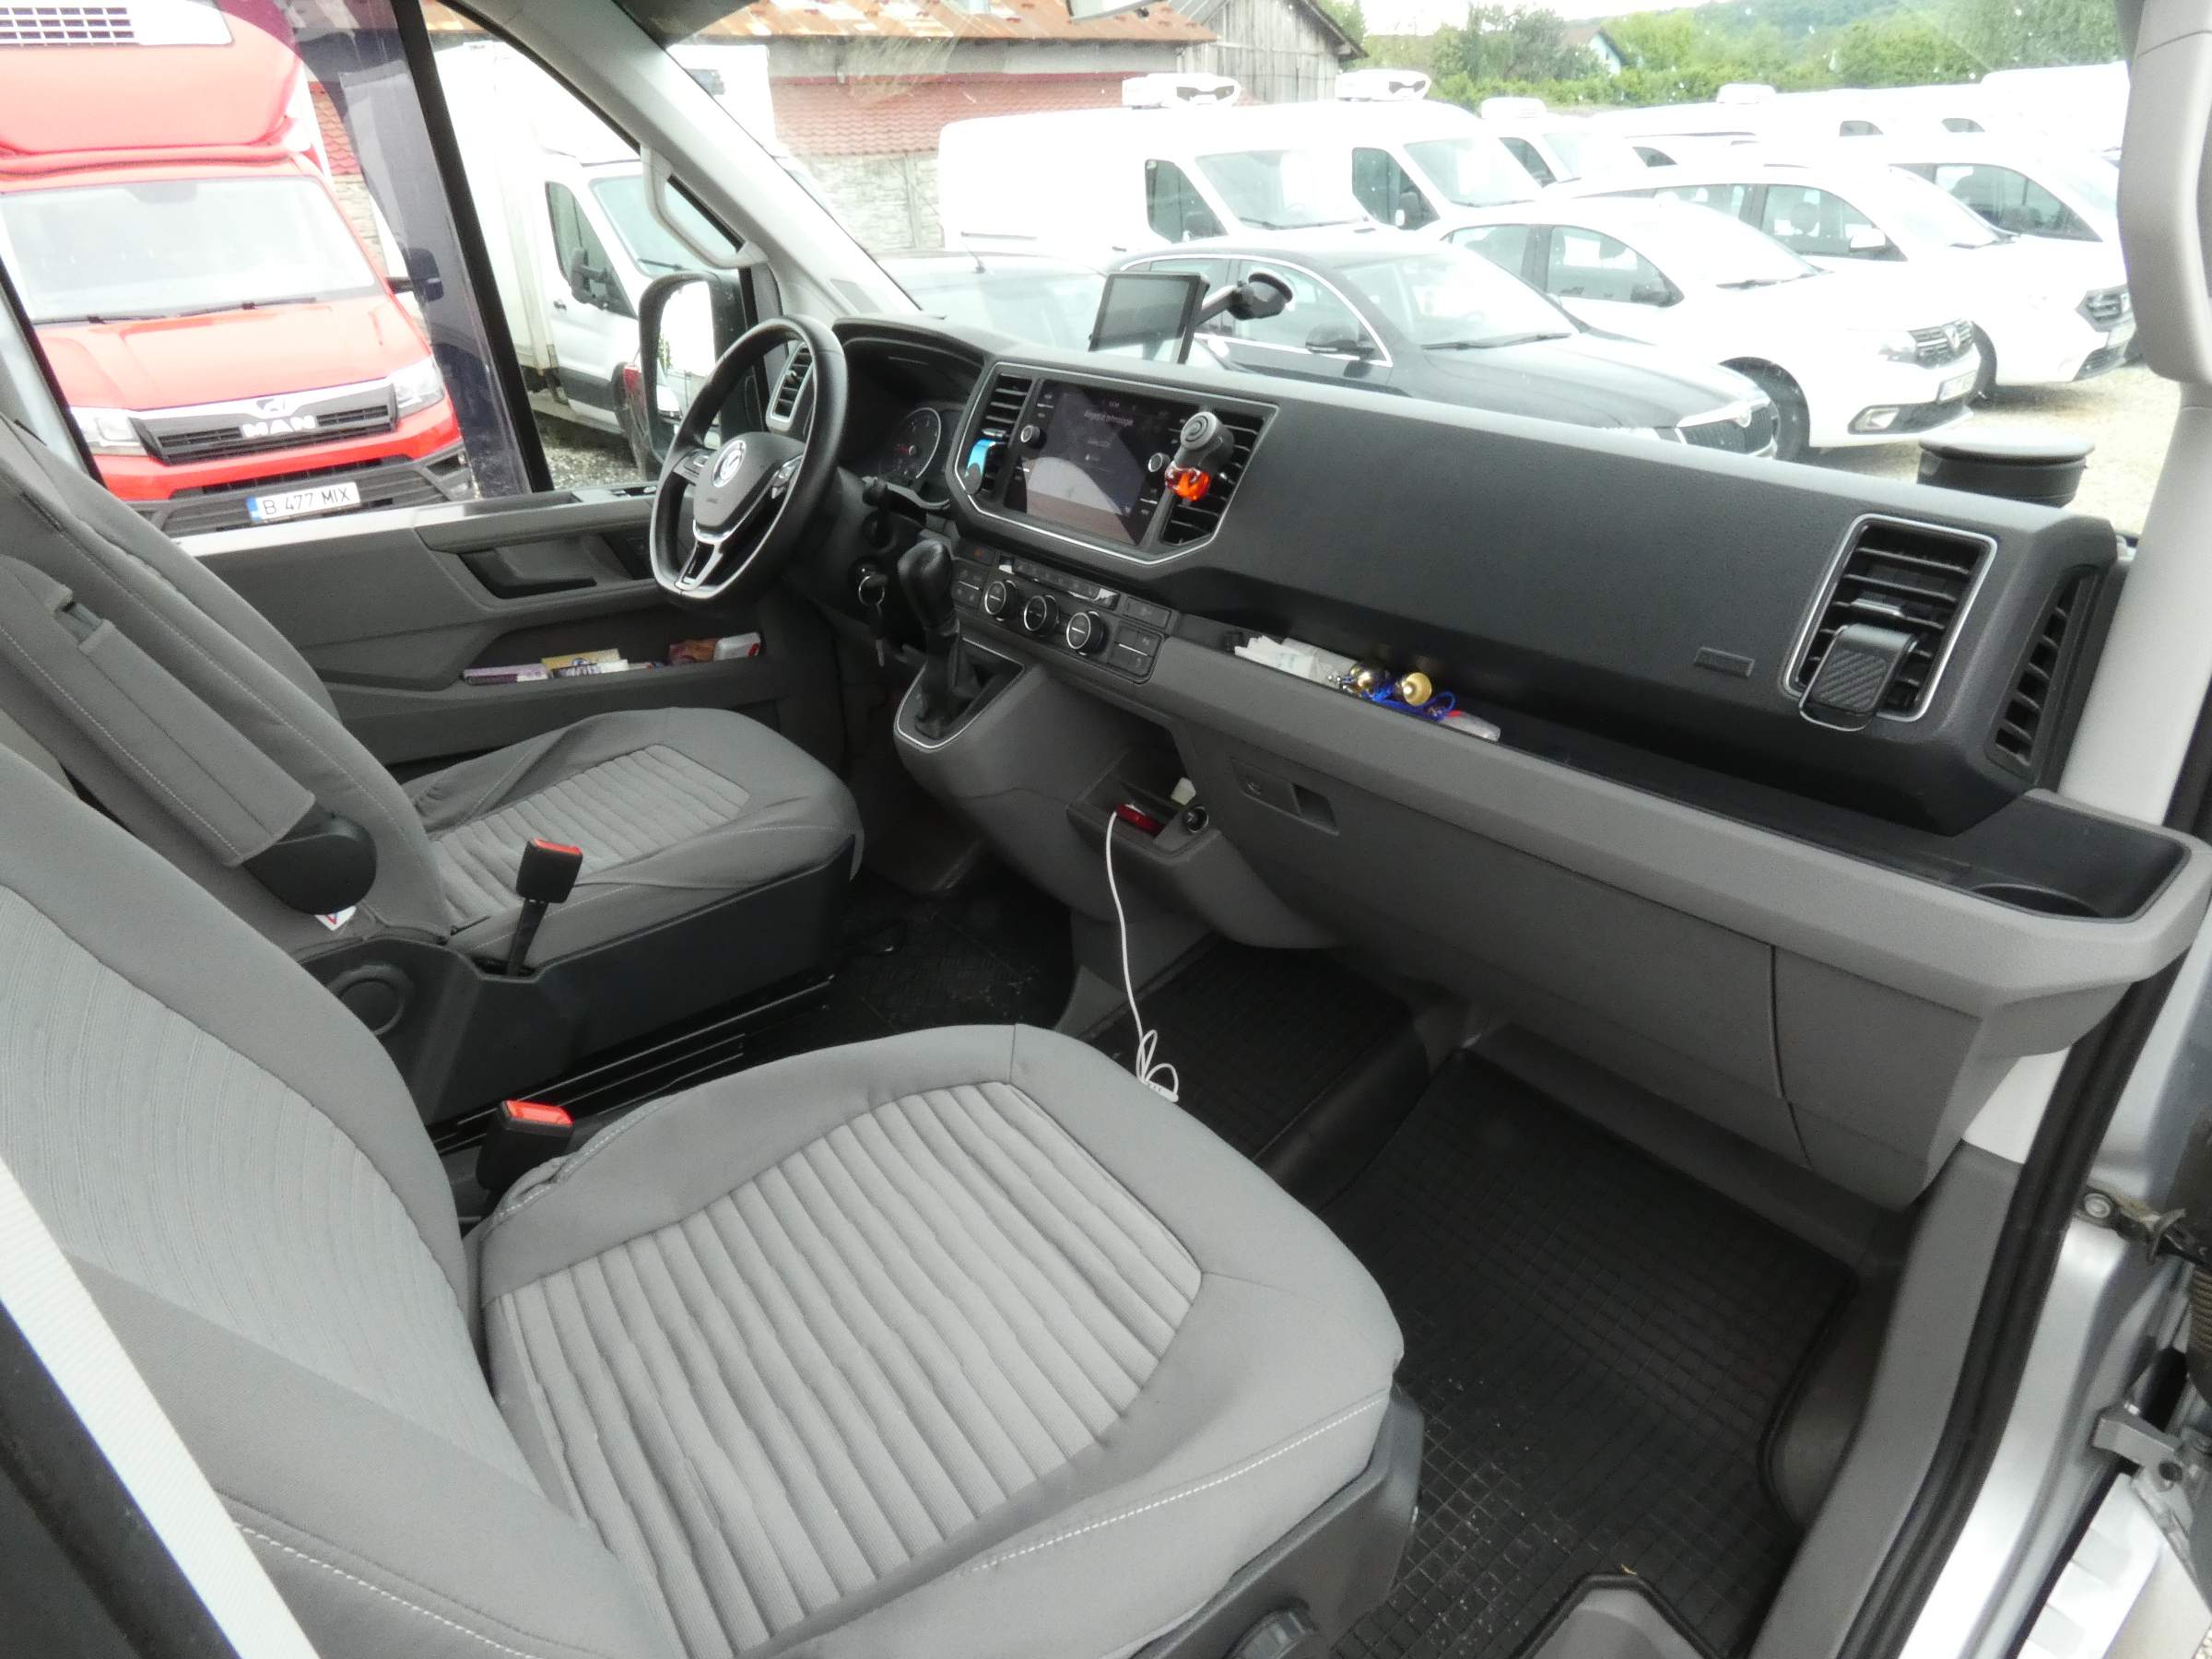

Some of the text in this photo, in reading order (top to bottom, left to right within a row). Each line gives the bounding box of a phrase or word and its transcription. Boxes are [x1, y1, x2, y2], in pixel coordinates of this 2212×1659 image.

[242, 415, 316, 438] MAN
[262, 487, 351, 516] B 477 MIX
